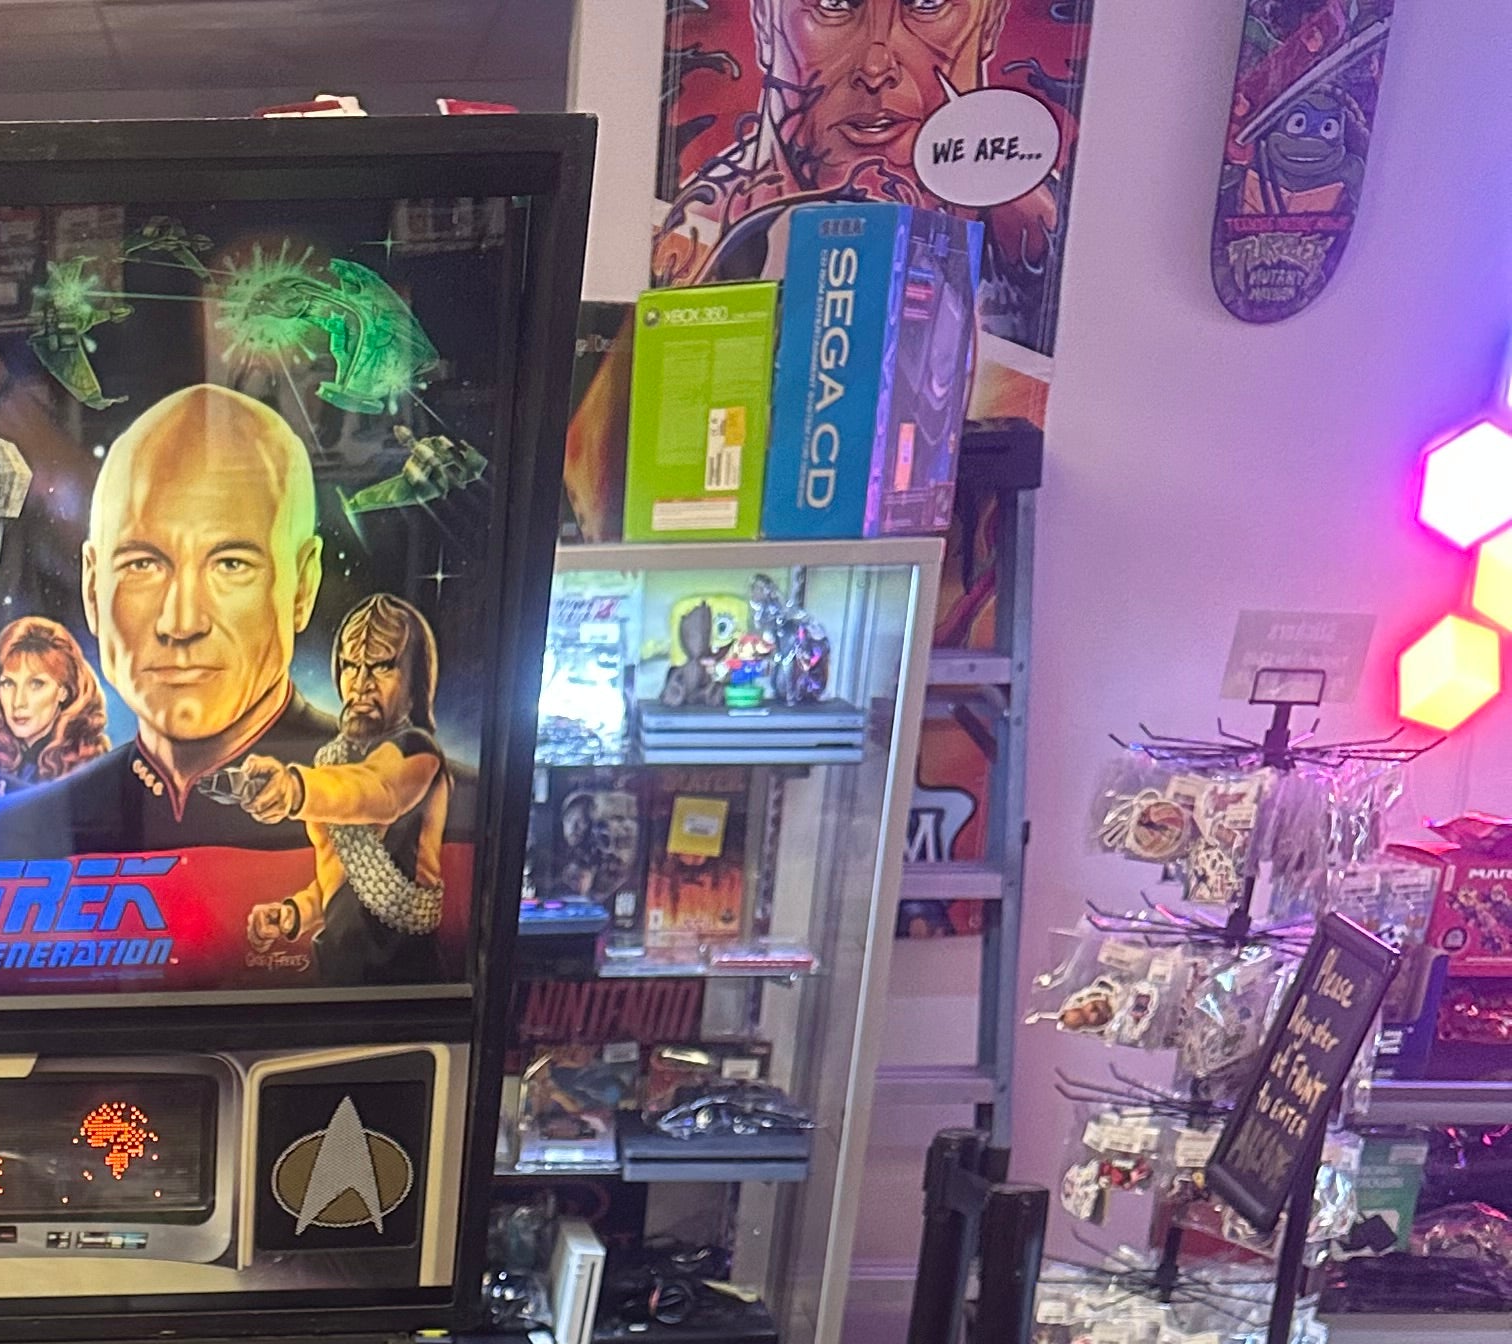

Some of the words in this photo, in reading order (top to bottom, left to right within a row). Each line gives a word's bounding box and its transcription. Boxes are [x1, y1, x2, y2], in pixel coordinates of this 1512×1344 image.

[931, 139, 966, 165] WE
[975, 137, 1043, 163] ARE...
[703, 306, 728, 320] 360
[815, 248, 858, 413] SEGA
[805, 423, 840, 508] CD
